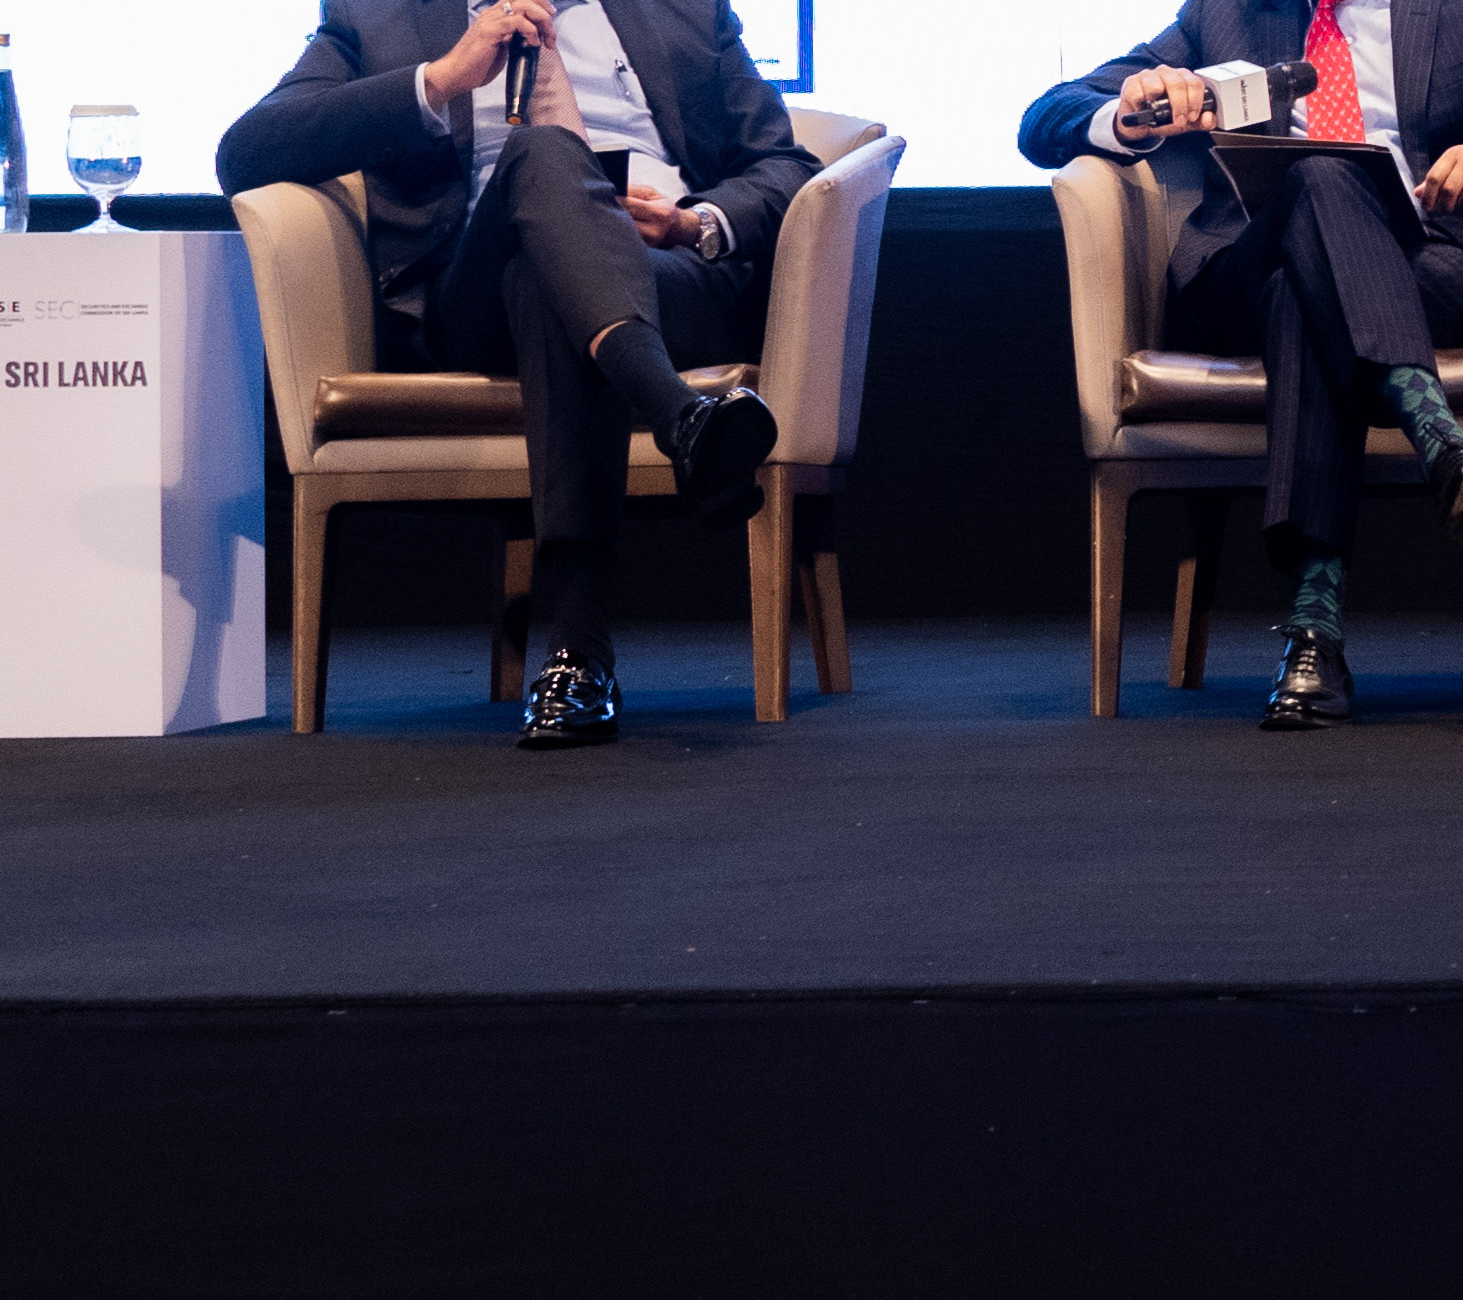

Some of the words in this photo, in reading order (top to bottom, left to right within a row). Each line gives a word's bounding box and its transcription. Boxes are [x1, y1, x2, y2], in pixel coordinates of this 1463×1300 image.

[35, 300, 75, 319] SEC
[5, 361, 49, 388] SRI
[58, 361, 148, 388] LANKA
